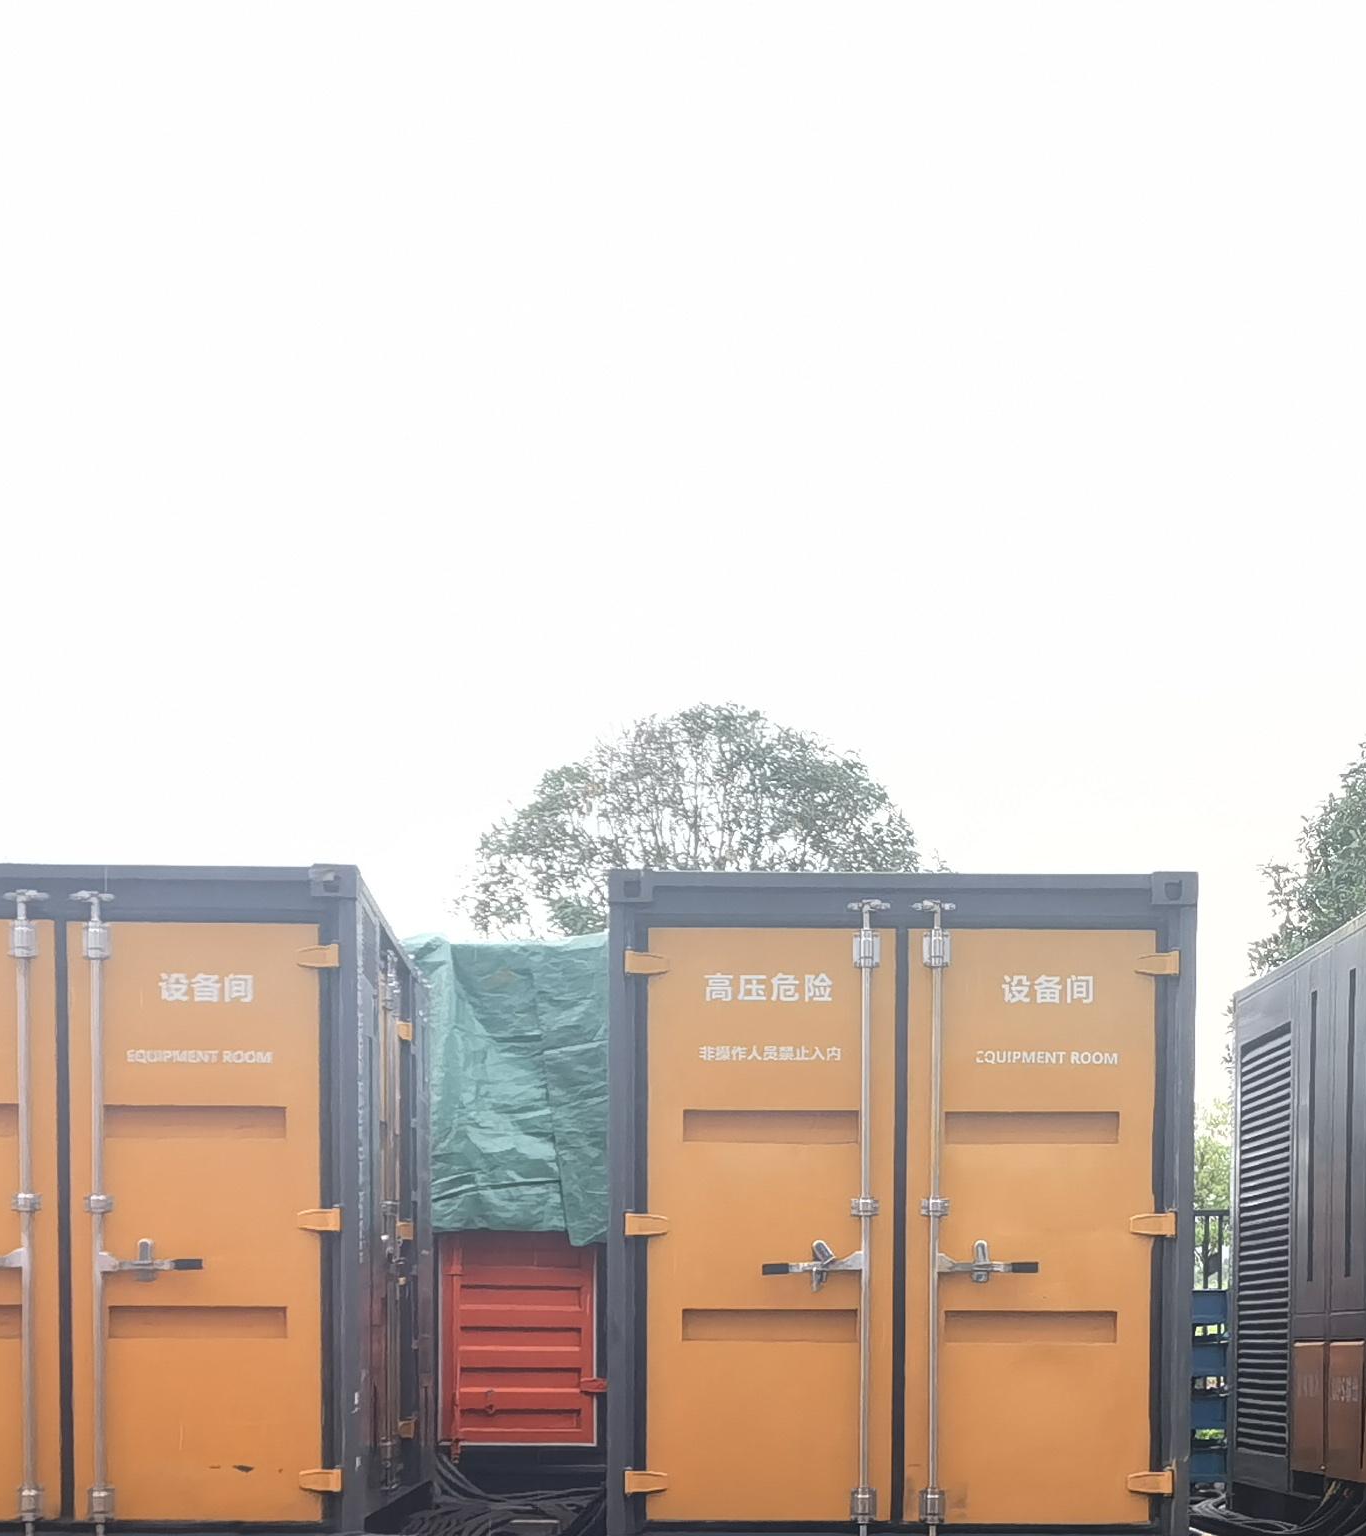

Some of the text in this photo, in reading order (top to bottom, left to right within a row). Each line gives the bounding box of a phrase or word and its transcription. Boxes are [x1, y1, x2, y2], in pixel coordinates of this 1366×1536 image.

[158, 973, 254, 1003] 设备间
[704, 973, 833, 1002] 高压危险
[1001, 975, 1094, 1004] 设备间
[126, 1049, 273, 1064] EQUIPMENT ROOM
[976, 1050, 1118, 1065] EQUIPMENT ROOM
